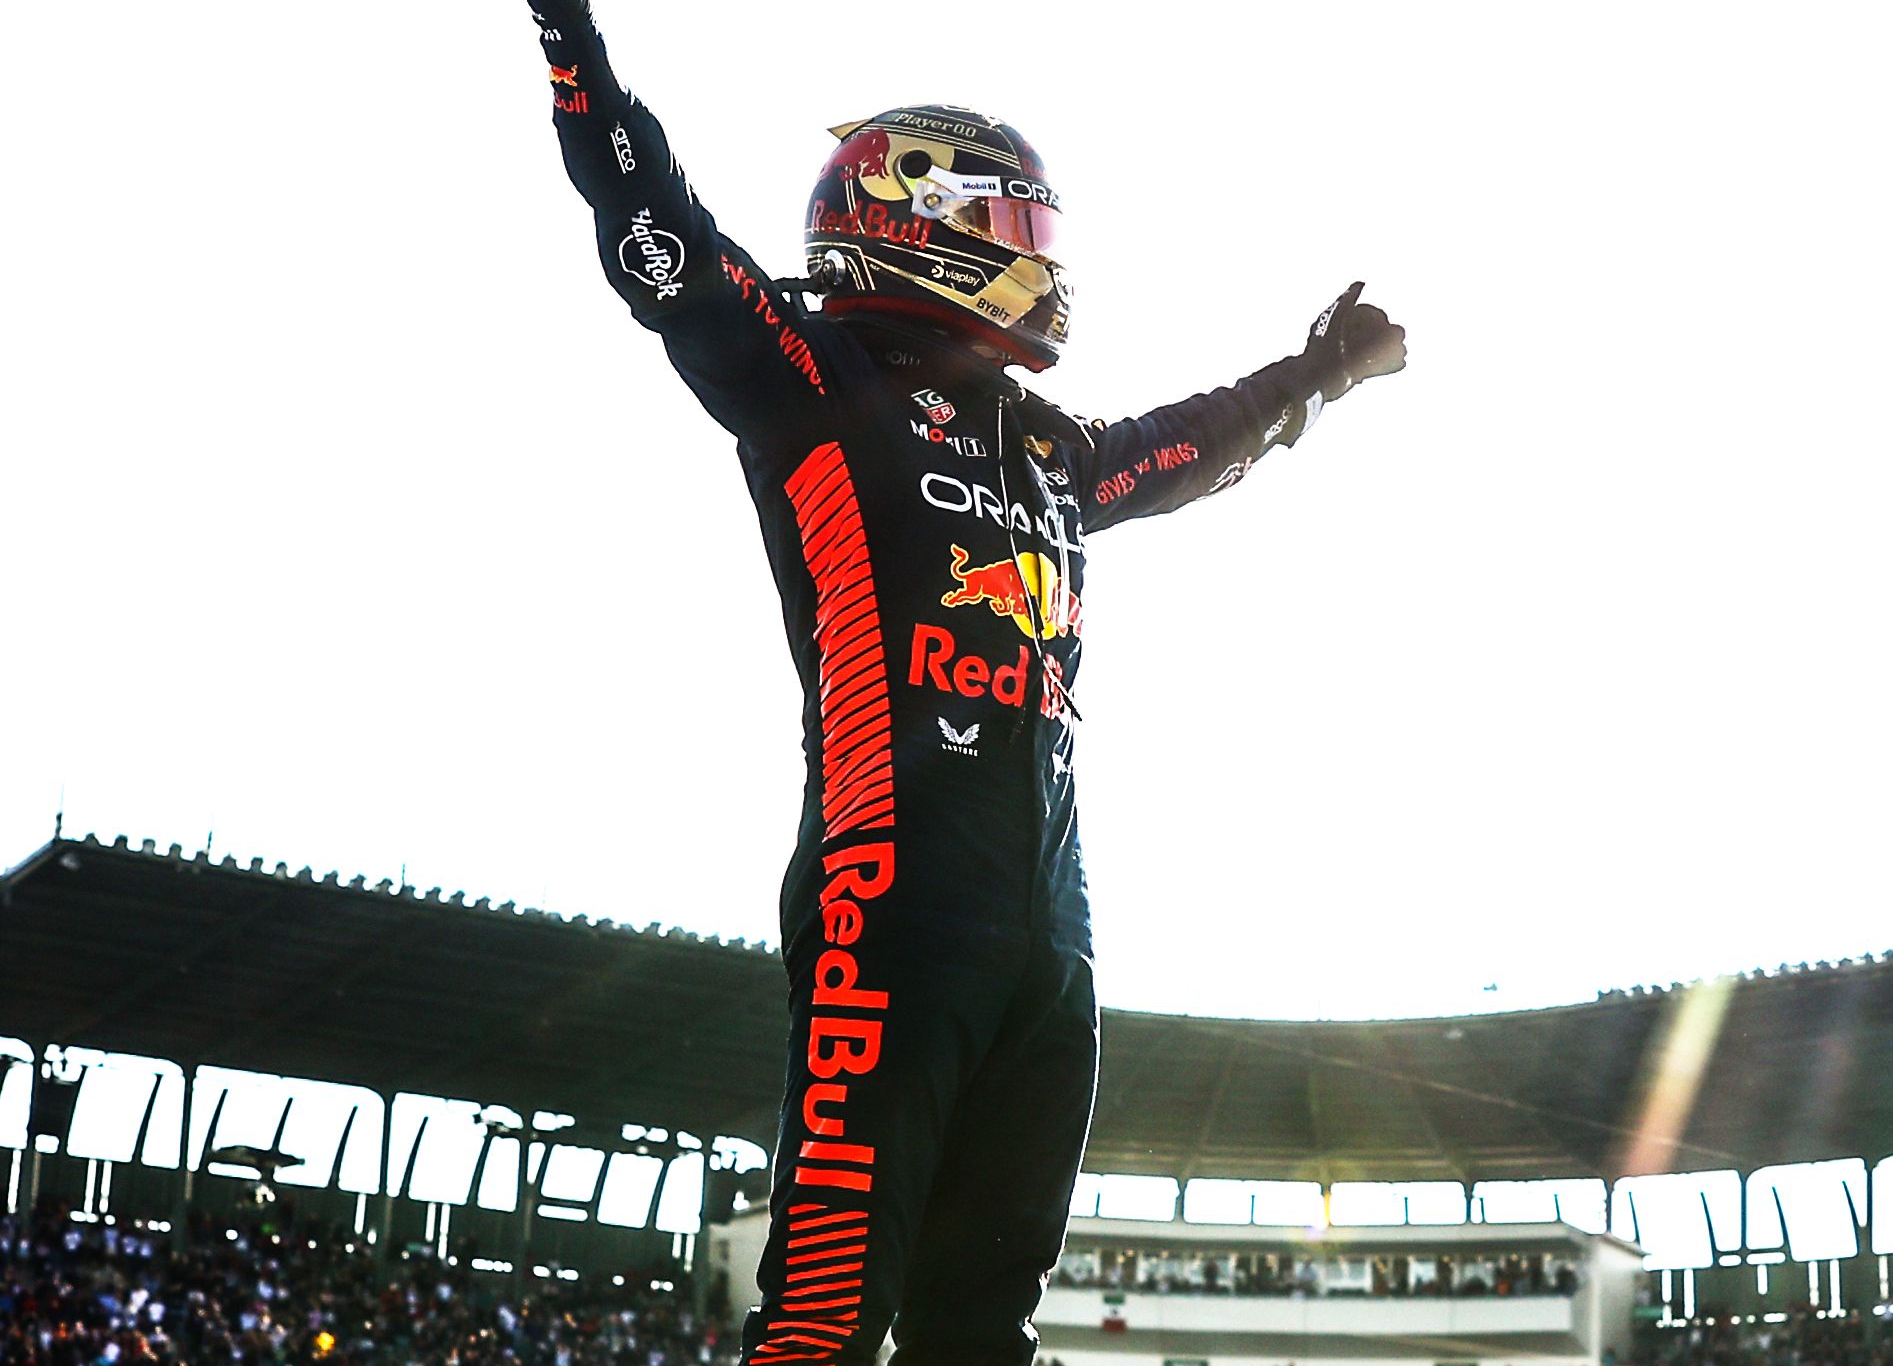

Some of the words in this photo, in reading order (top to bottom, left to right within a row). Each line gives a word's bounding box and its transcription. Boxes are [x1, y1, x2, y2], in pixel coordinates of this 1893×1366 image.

[894, 112, 953, 131] Player
[611, 123, 636, 174] arco
[945, 270, 980, 286] viaplay
[976, 297, 1011, 323] BYBIT
[908, 622, 1029, 708] Red
